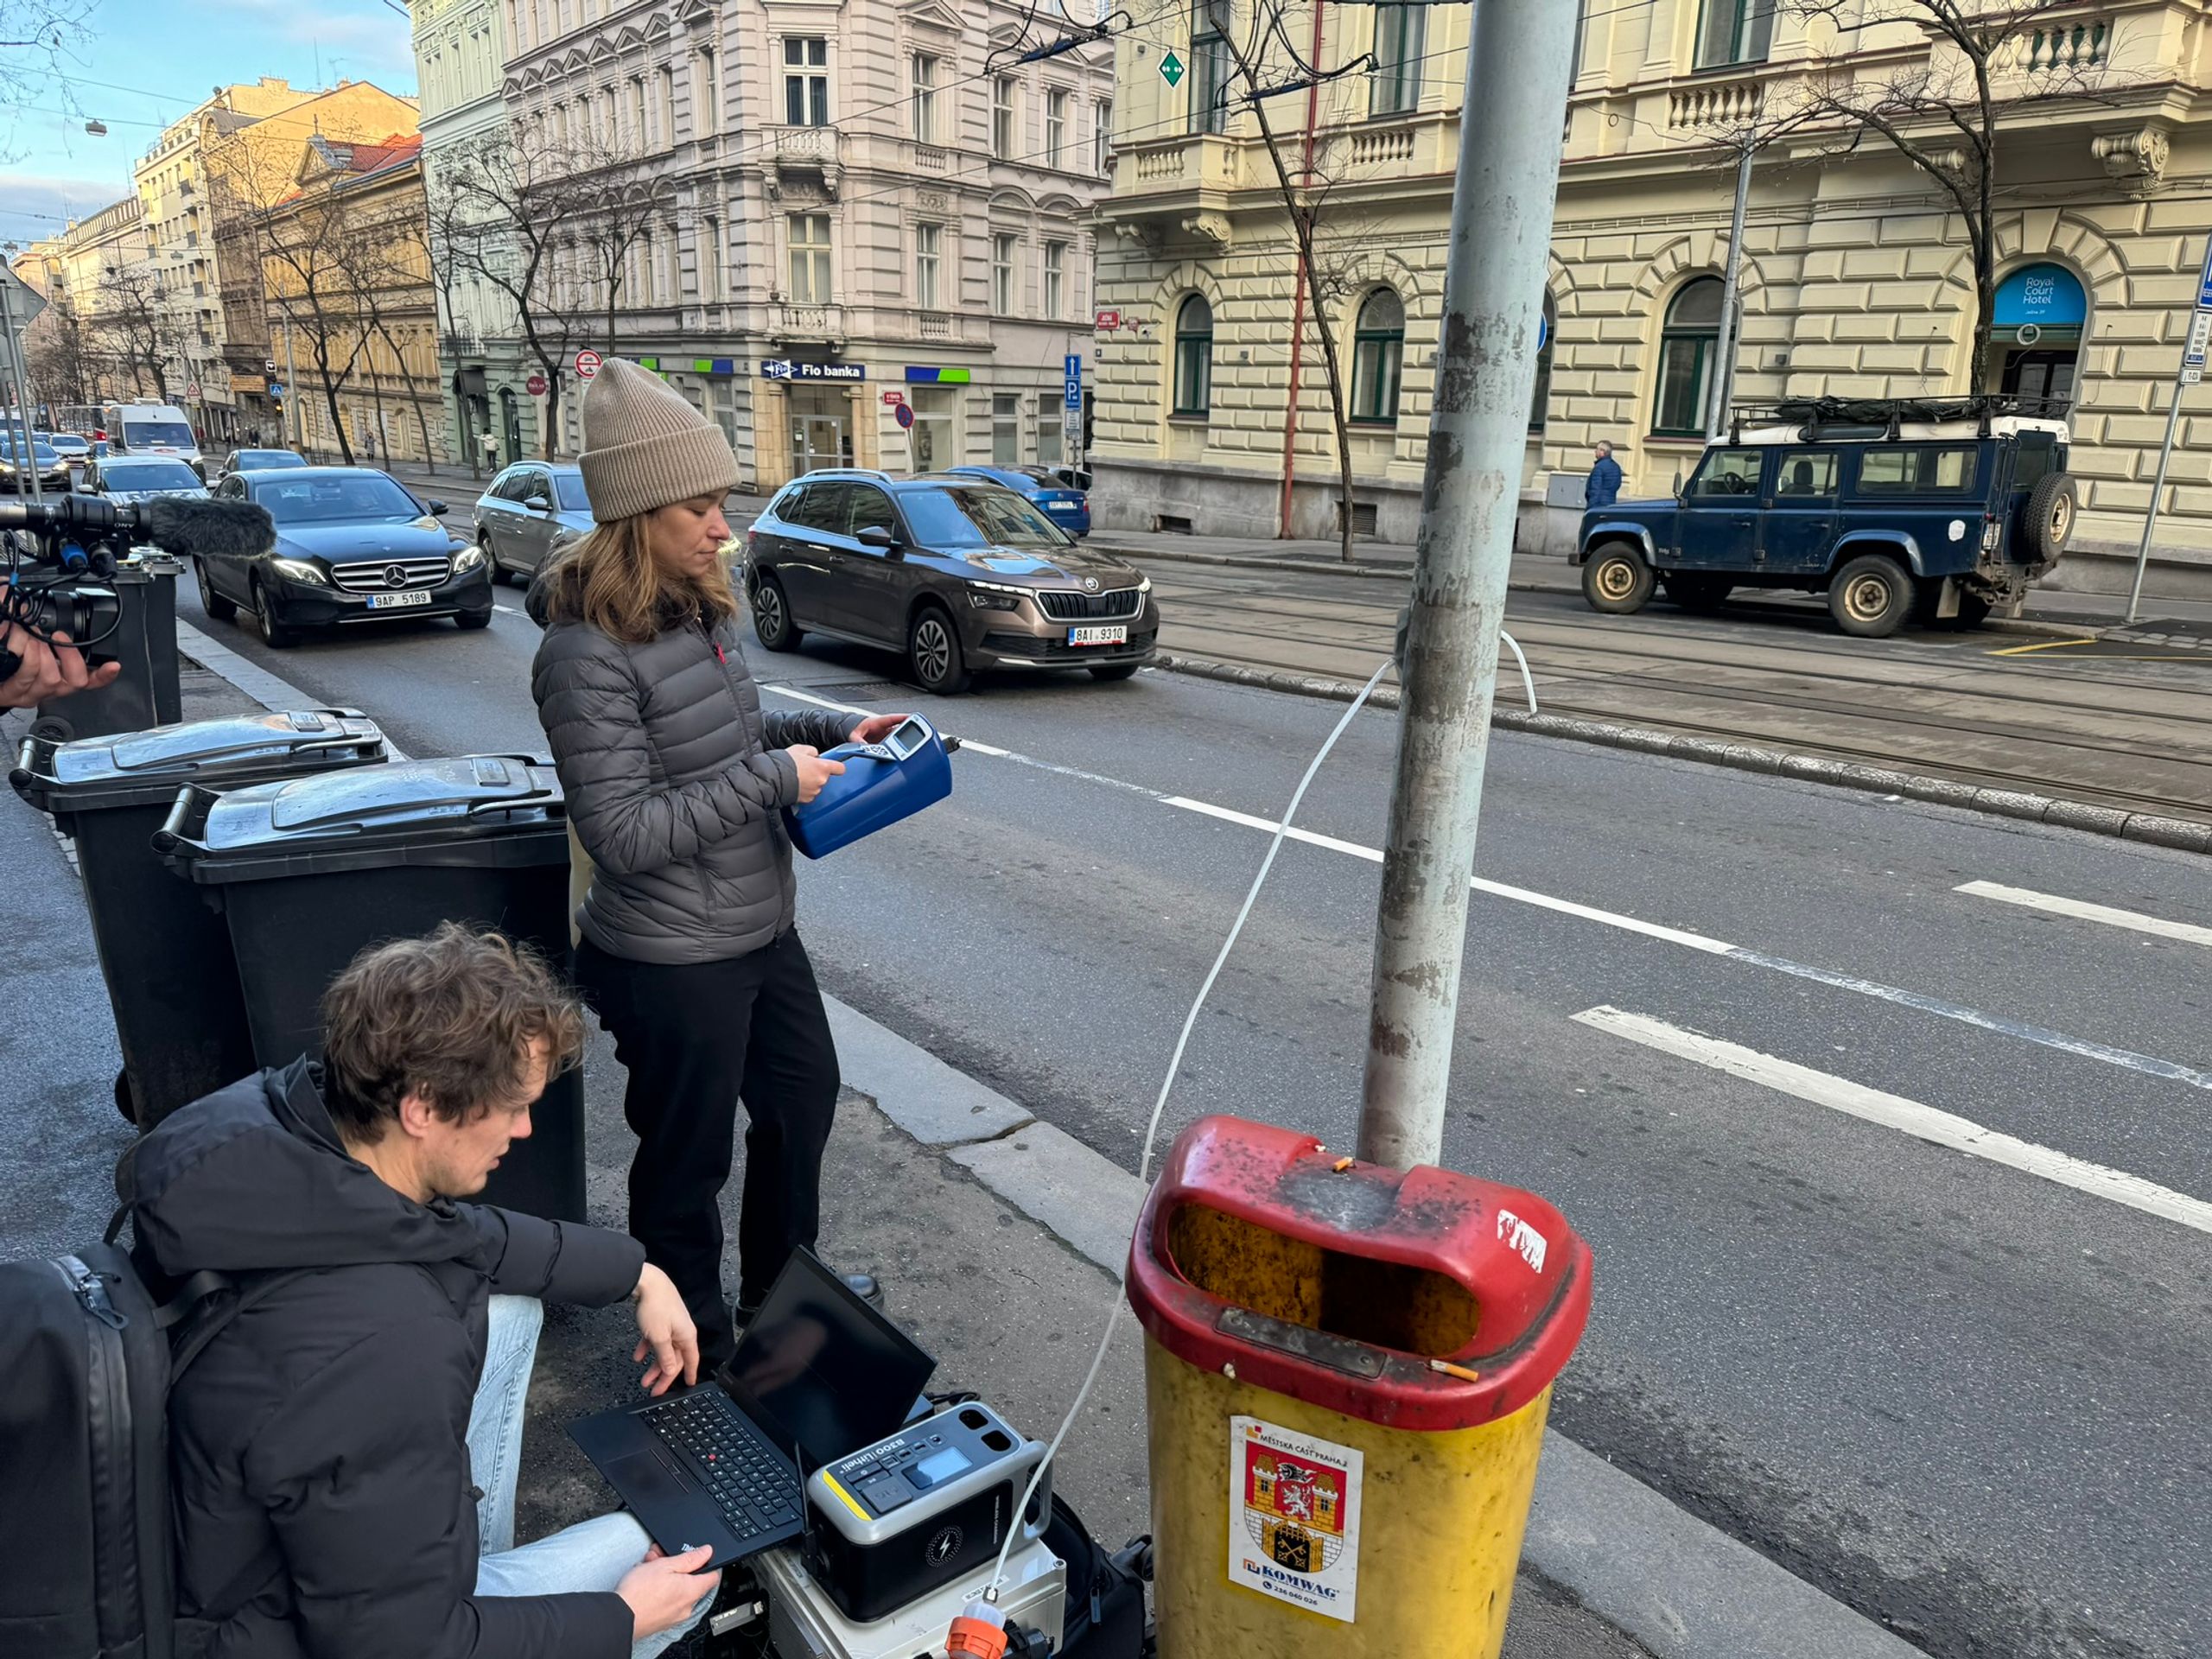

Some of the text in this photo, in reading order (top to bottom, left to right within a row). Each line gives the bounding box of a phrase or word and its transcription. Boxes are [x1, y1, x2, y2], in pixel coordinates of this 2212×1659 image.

[2026, 276, 2055, 288] Royal
[2024, 286, 2054, 296] Court
[2023, 295, 2052, 304] Hotel
[802, 364, 861, 378] Fio banka
[375, 593, 427, 607] 9AP 5189
[1100, 627, 1122, 639] 9310
[1262, 1565, 1337, 1599] KOMWAG
